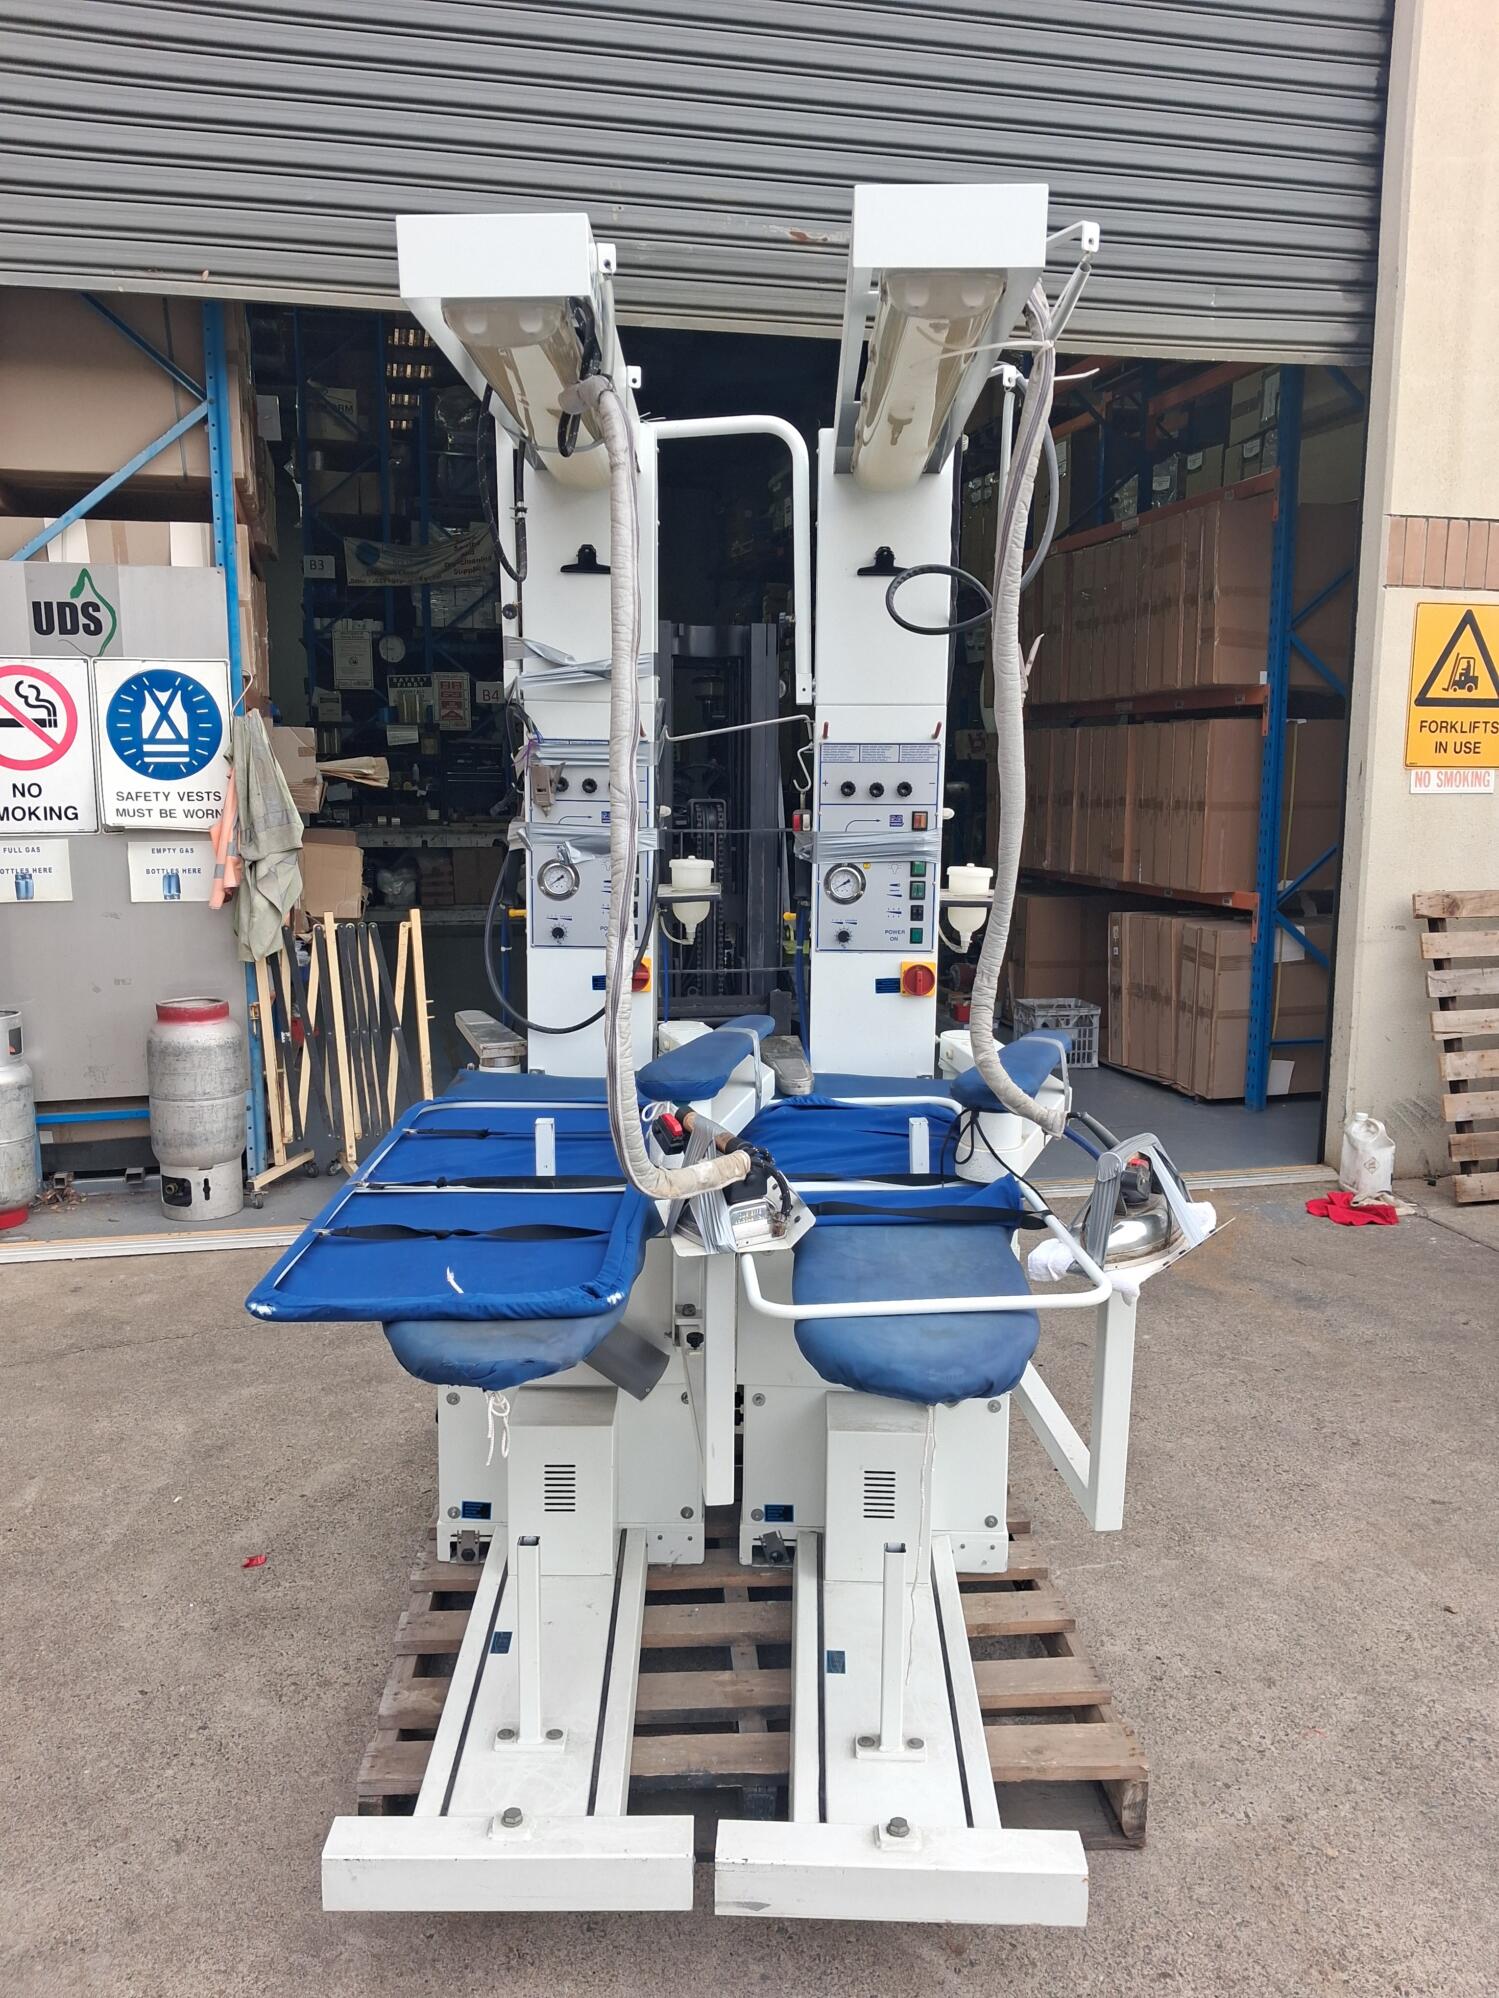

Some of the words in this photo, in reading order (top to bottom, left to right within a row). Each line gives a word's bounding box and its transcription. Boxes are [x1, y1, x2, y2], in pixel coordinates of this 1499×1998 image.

[310, 559, 325, 570] B3
[32, 601, 103, 636] UDS
[482, 689, 500, 702] B4
[1419, 720, 1499, 734] FORKLIFTS
[1434, 741, 1448, 754] IN
[1453, 741, 1482, 754] USE
[1415, 770, 1431, 788] NO
[1436, 770, 1490, 788] SMOKING
[12, 783, 42, 798] NO
[116, 791, 171, 801] SAFETY
[177, 791, 222, 801] VESTS
[116, 808, 153, 818] MUST
[160, 808, 177, 819] BE
[151, 847, 177, 855] EMPTY
[32, 866, 53, 874] HERE
[145, 867, 180, 875] BOTTLES
